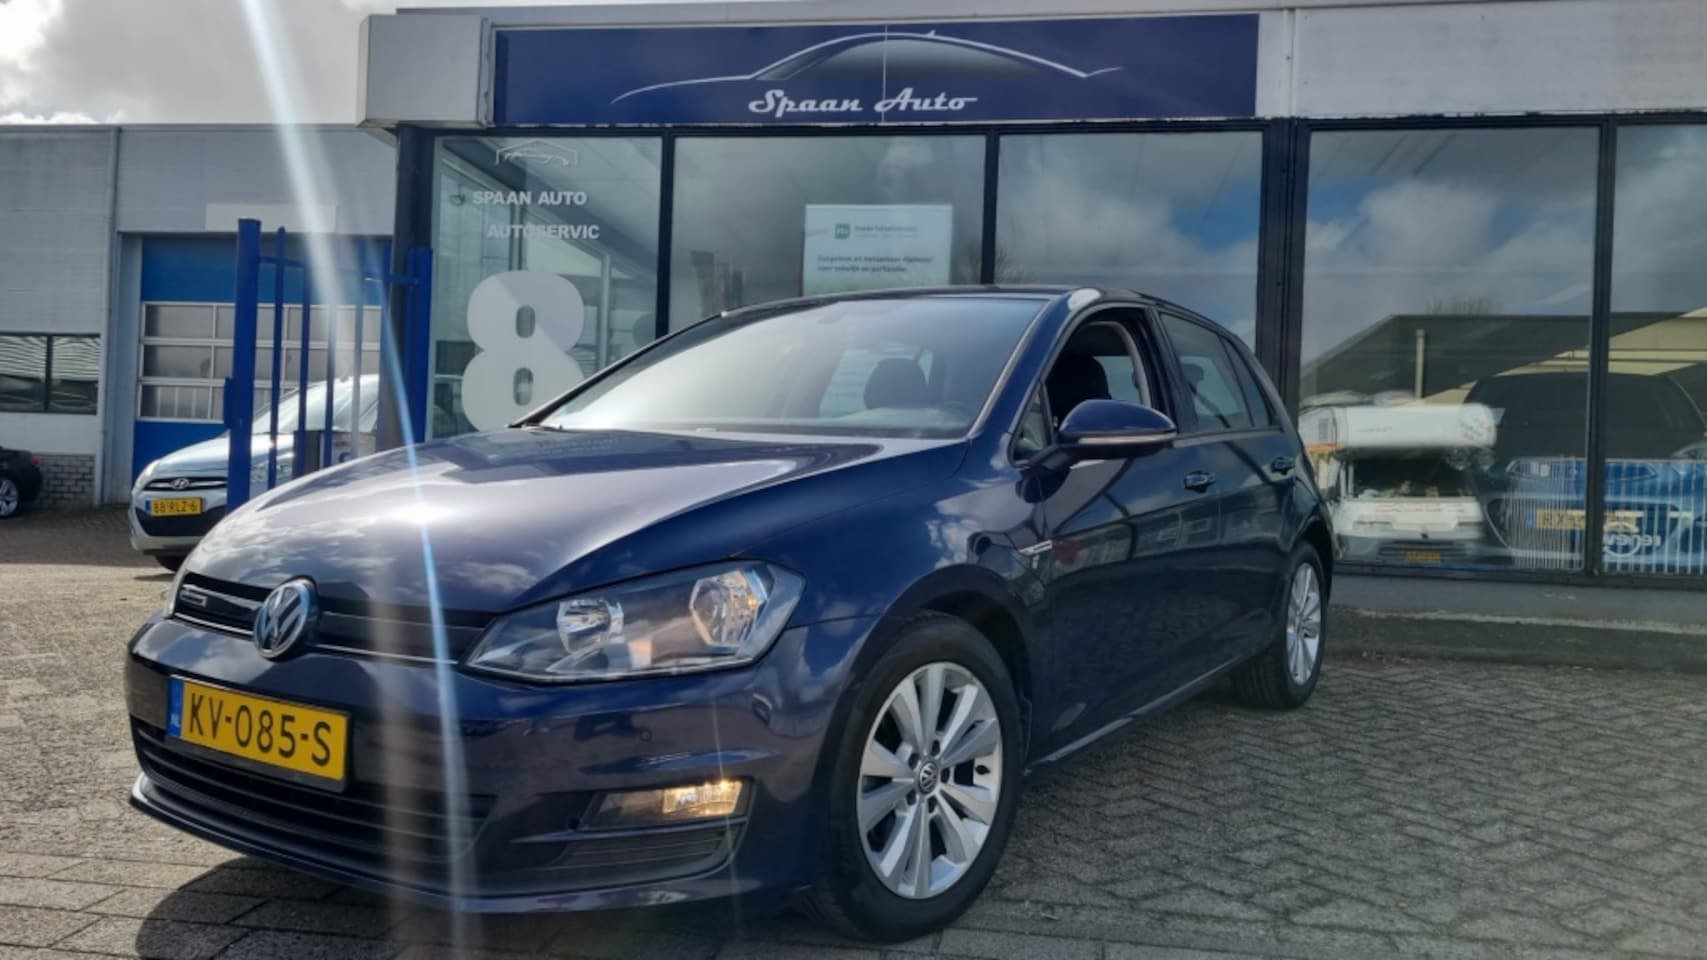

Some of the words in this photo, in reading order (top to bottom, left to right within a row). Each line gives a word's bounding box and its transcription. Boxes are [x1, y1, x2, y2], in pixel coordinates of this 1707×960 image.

[748, 88, 864, 118] Spaan
[873, 87, 978, 112] Auto
[472, 191, 532, 206] SPAAN
[537, 191, 587, 206] AUTO
[487, 224, 600, 239] AUTOSERVIC
[461, 270, 584, 432] 8
[189, 692, 331, 766] KV-085-S
